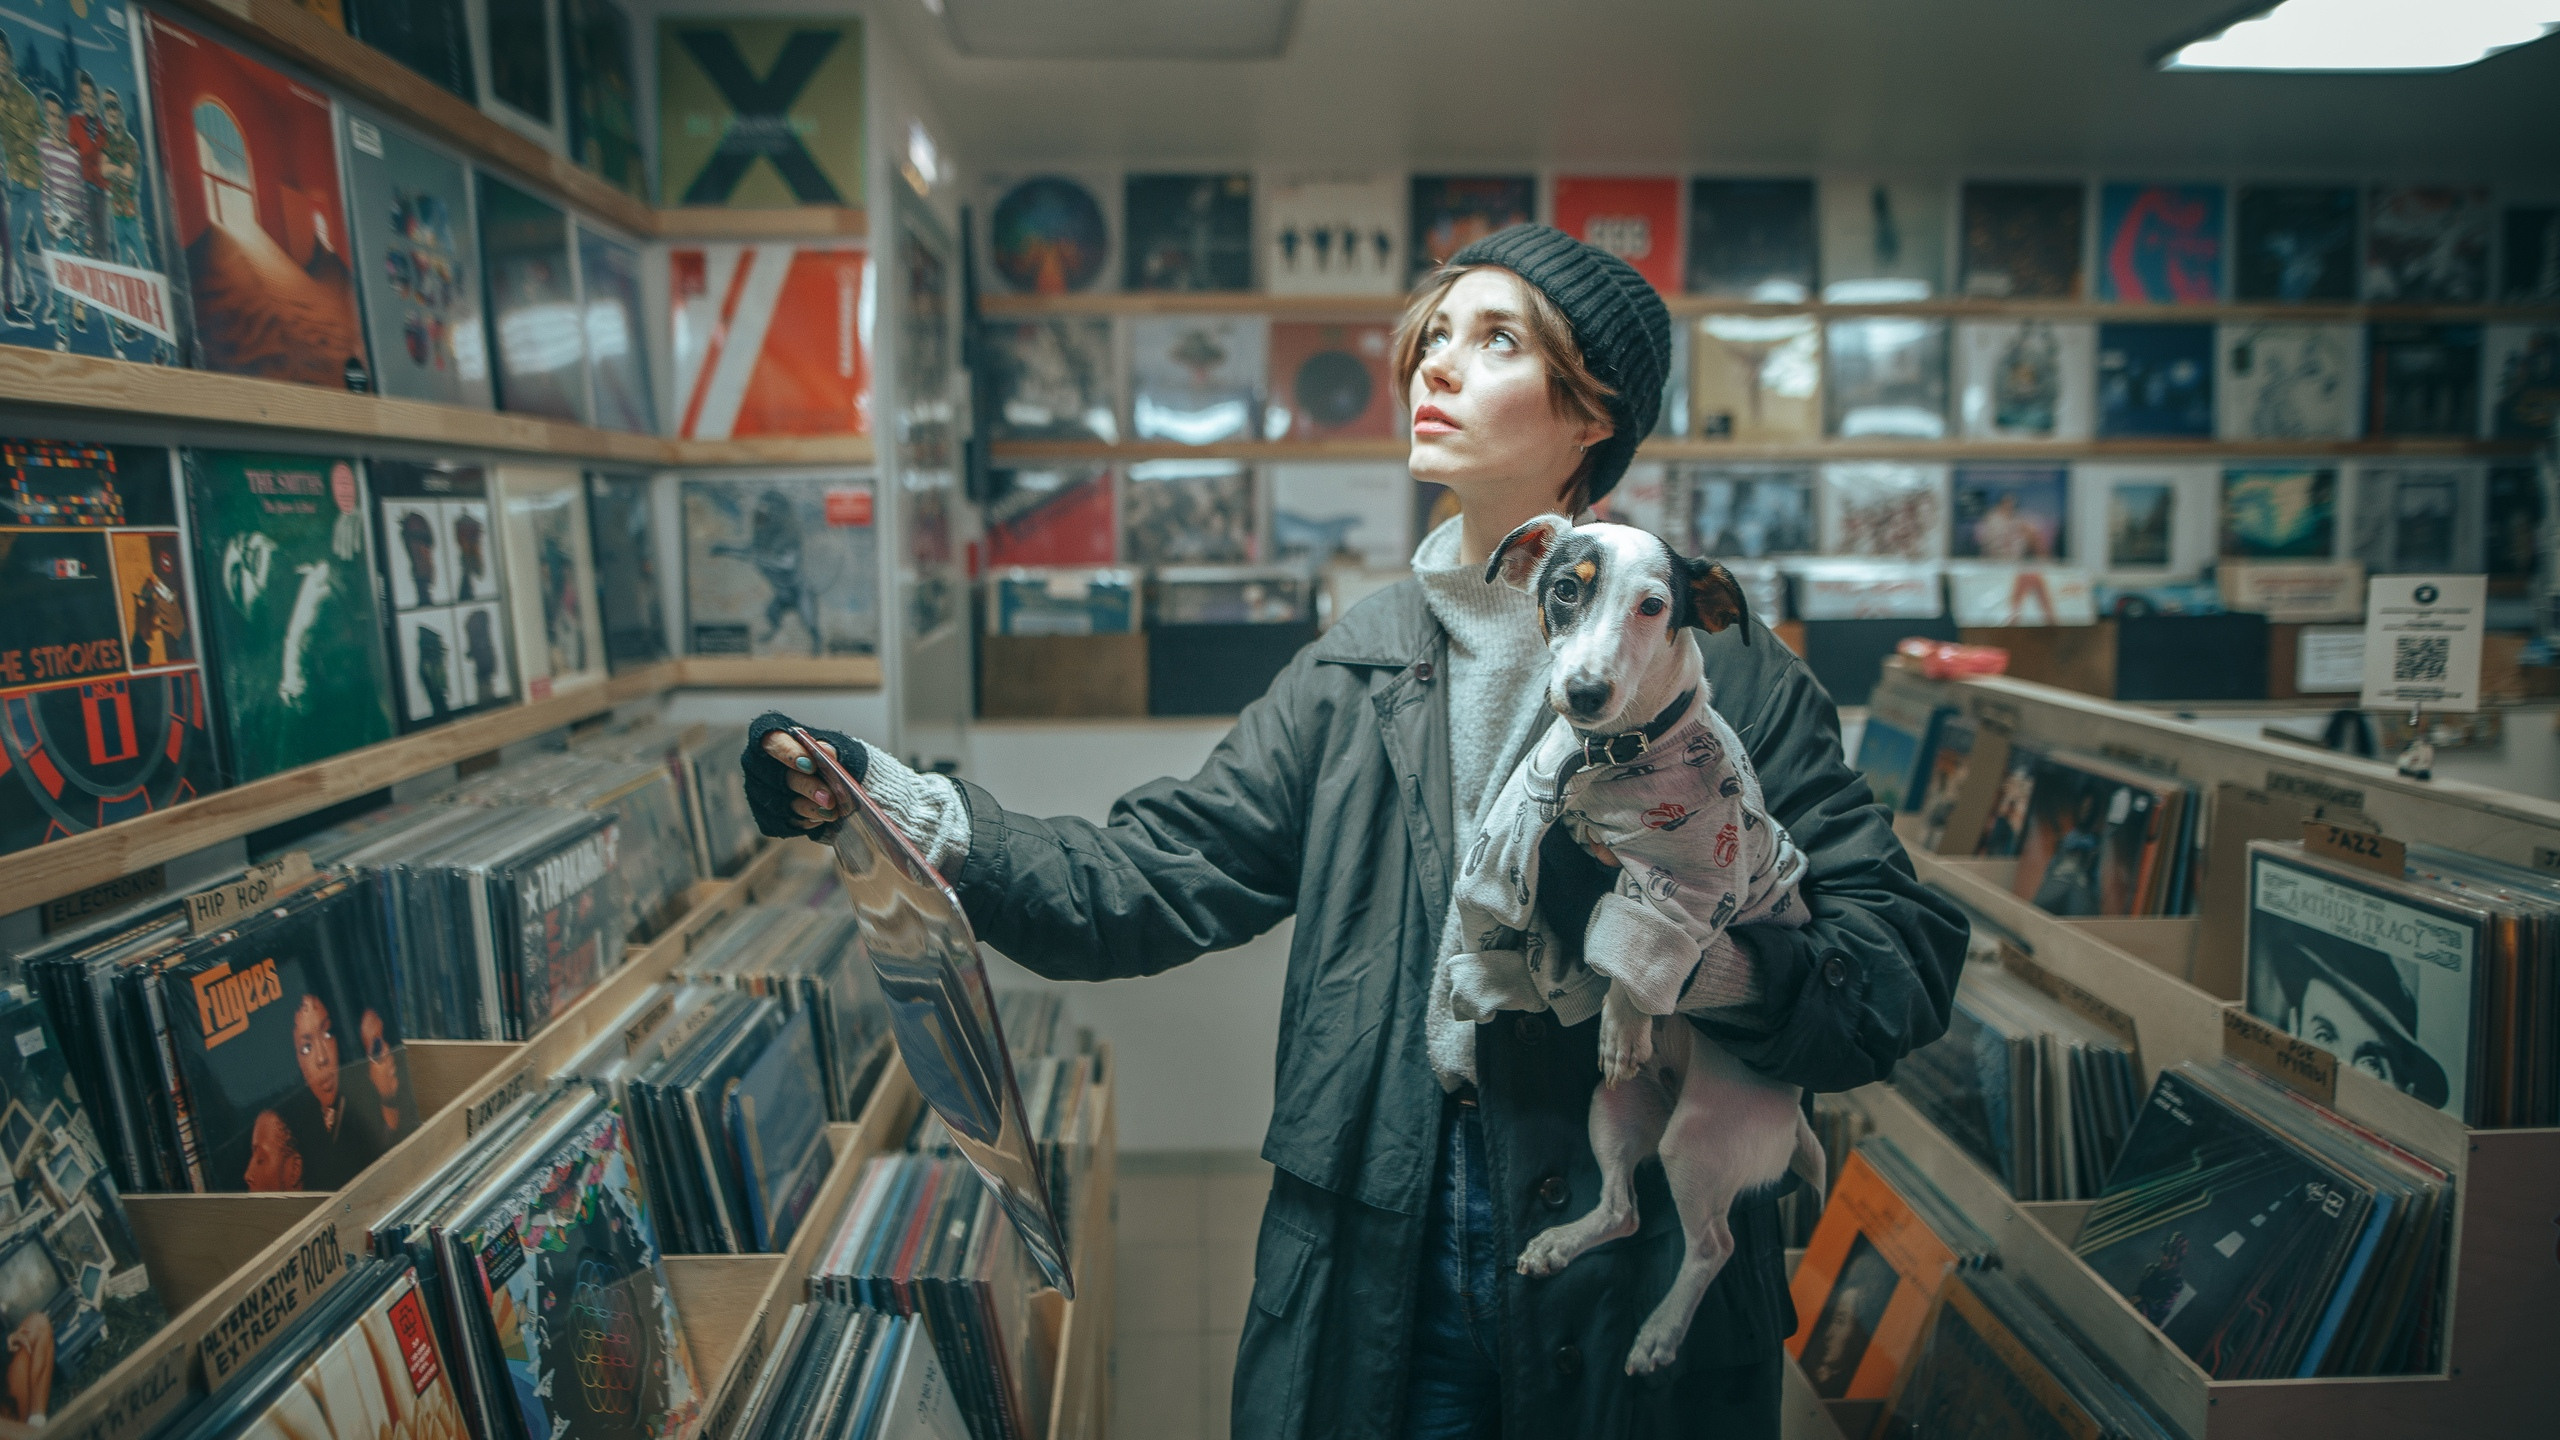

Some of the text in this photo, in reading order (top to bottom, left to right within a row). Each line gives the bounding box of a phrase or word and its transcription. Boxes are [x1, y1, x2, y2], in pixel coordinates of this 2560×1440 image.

[29, 638, 122, 679] STROKES
[2327, 825, 2383, 859] JAZZ
[196, 878, 268, 921] HIP HOP
[2288, 887, 2358, 928] ARTHUR
[2363, 911, 2425, 948] TRACY
[190, 957, 283, 1052] Fugees
[203, 1222, 343, 1358] ALTERNATIVE ROCK
[214, 1287, 297, 1377] EXTREME
